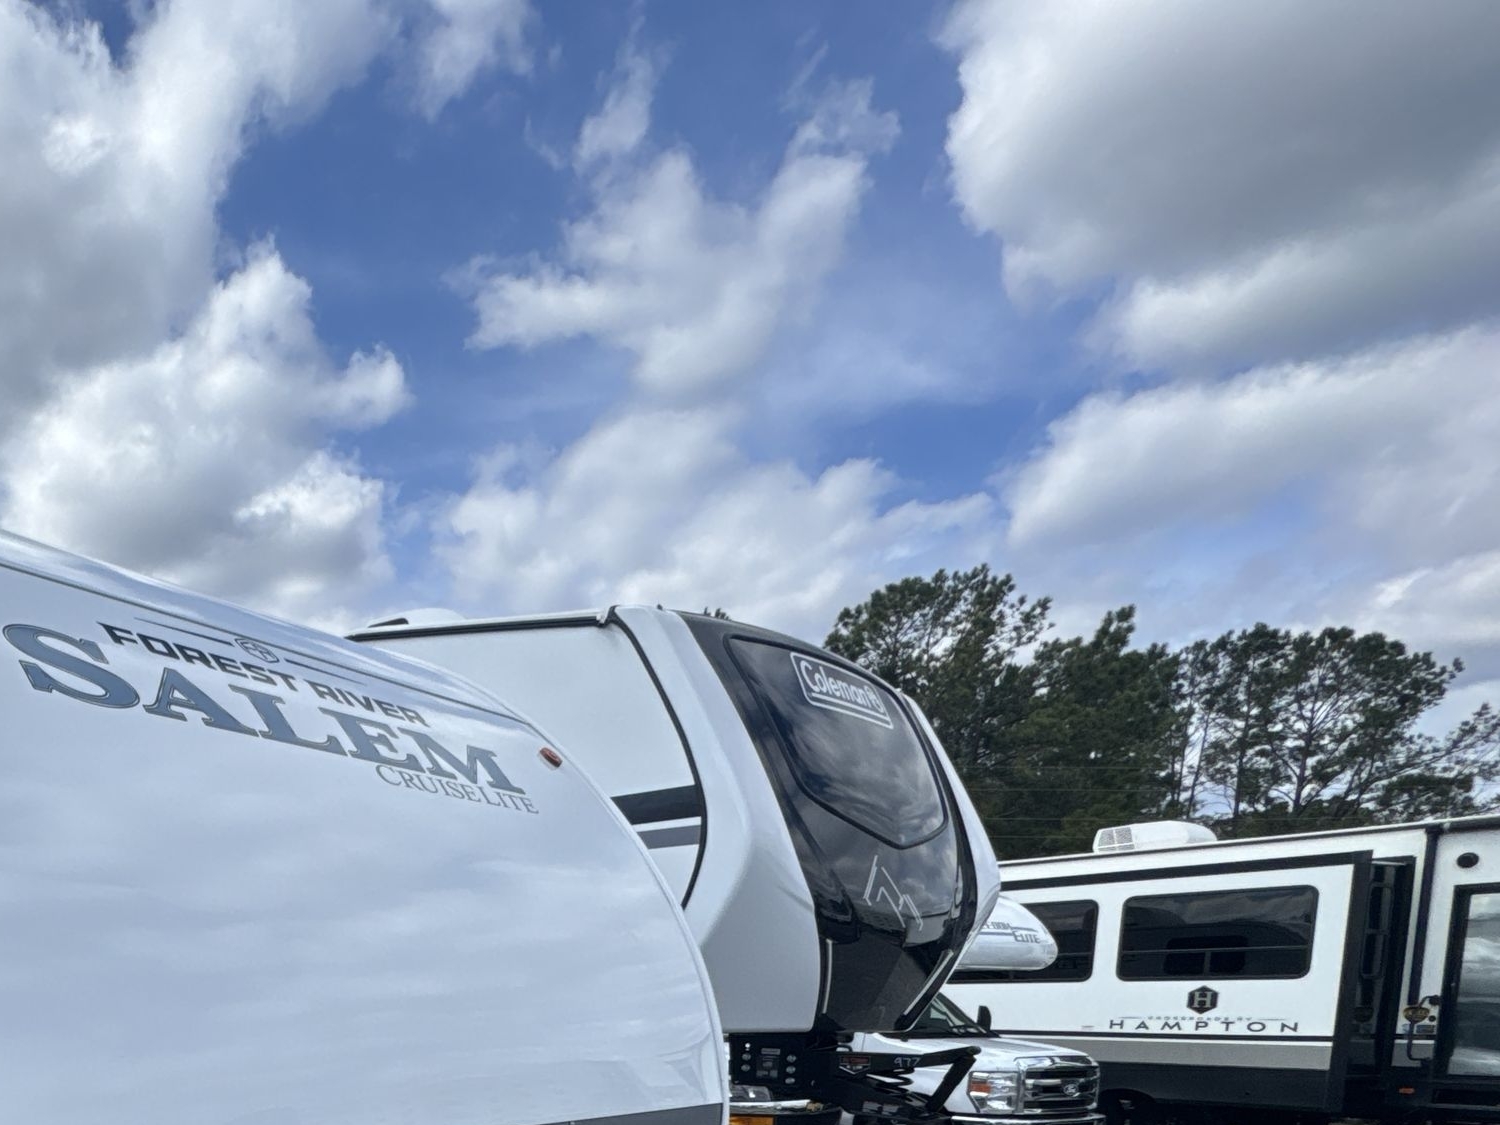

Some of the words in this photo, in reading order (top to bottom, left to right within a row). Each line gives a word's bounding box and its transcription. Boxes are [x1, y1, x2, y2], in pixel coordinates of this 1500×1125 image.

[97, 621, 299, 692] FOREST
[304, 680, 431, 727] RIVER
[800, 660, 873, 709] Coleman
[2, 623, 526, 796] SALEM
[1191, 991, 1213, 1009] H
[1109, 1020, 1299, 1033] HAMPTON
